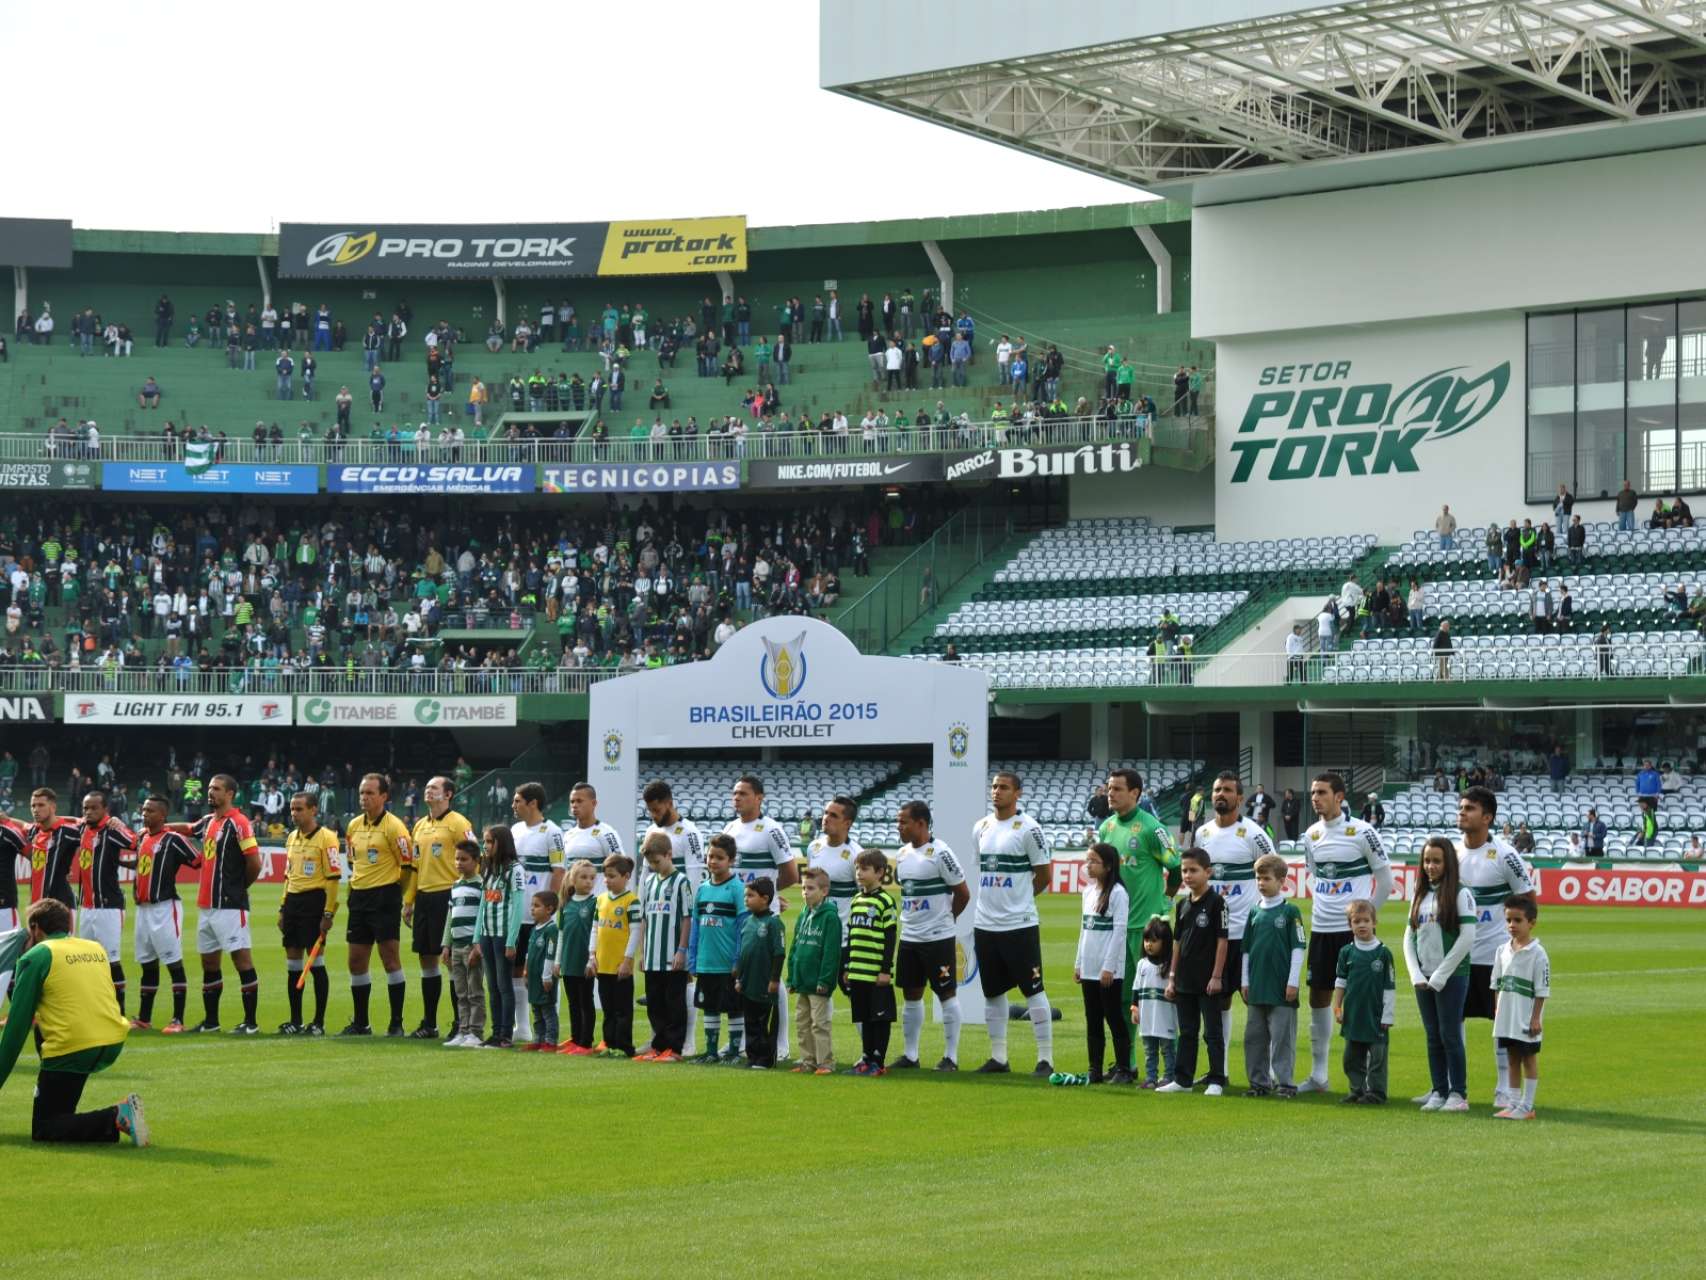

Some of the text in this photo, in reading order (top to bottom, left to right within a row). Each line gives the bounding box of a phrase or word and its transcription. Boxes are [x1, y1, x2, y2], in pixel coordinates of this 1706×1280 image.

[378, 237, 577, 258] PRO TORK
[621, 234, 737, 259] protork
[1258, 360, 1352, 386] SETOR
[1238, 383, 1392, 433] PRO
[946, 443, 1140, 480] ARROZ Buriti
[1230, 427, 1432, 483] TORK
[2, 463, 51, 474] IMPOSTO
[129, 469, 167, 479] NET
[255, 471, 291, 481] NET
[778, 462, 882, 480] NIKE.COM/FUTEBOL
[113, 703, 244, 716] LIGHT FM 95.1
[333, 704, 397, 720] ITAMBÉ
[443, 704, 505, 720] ITAMBÉ
[690, 700, 878, 723] BRASILEIRÃO 2015
[731, 724, 835, 739] CHEVROLET
[981, 876, 1013, 888] AIXA
[1559, 876, 1581, 900] O
[1585, 877, 1684, 902] SABOR
[66, 951, 107, 965] GANDULA
